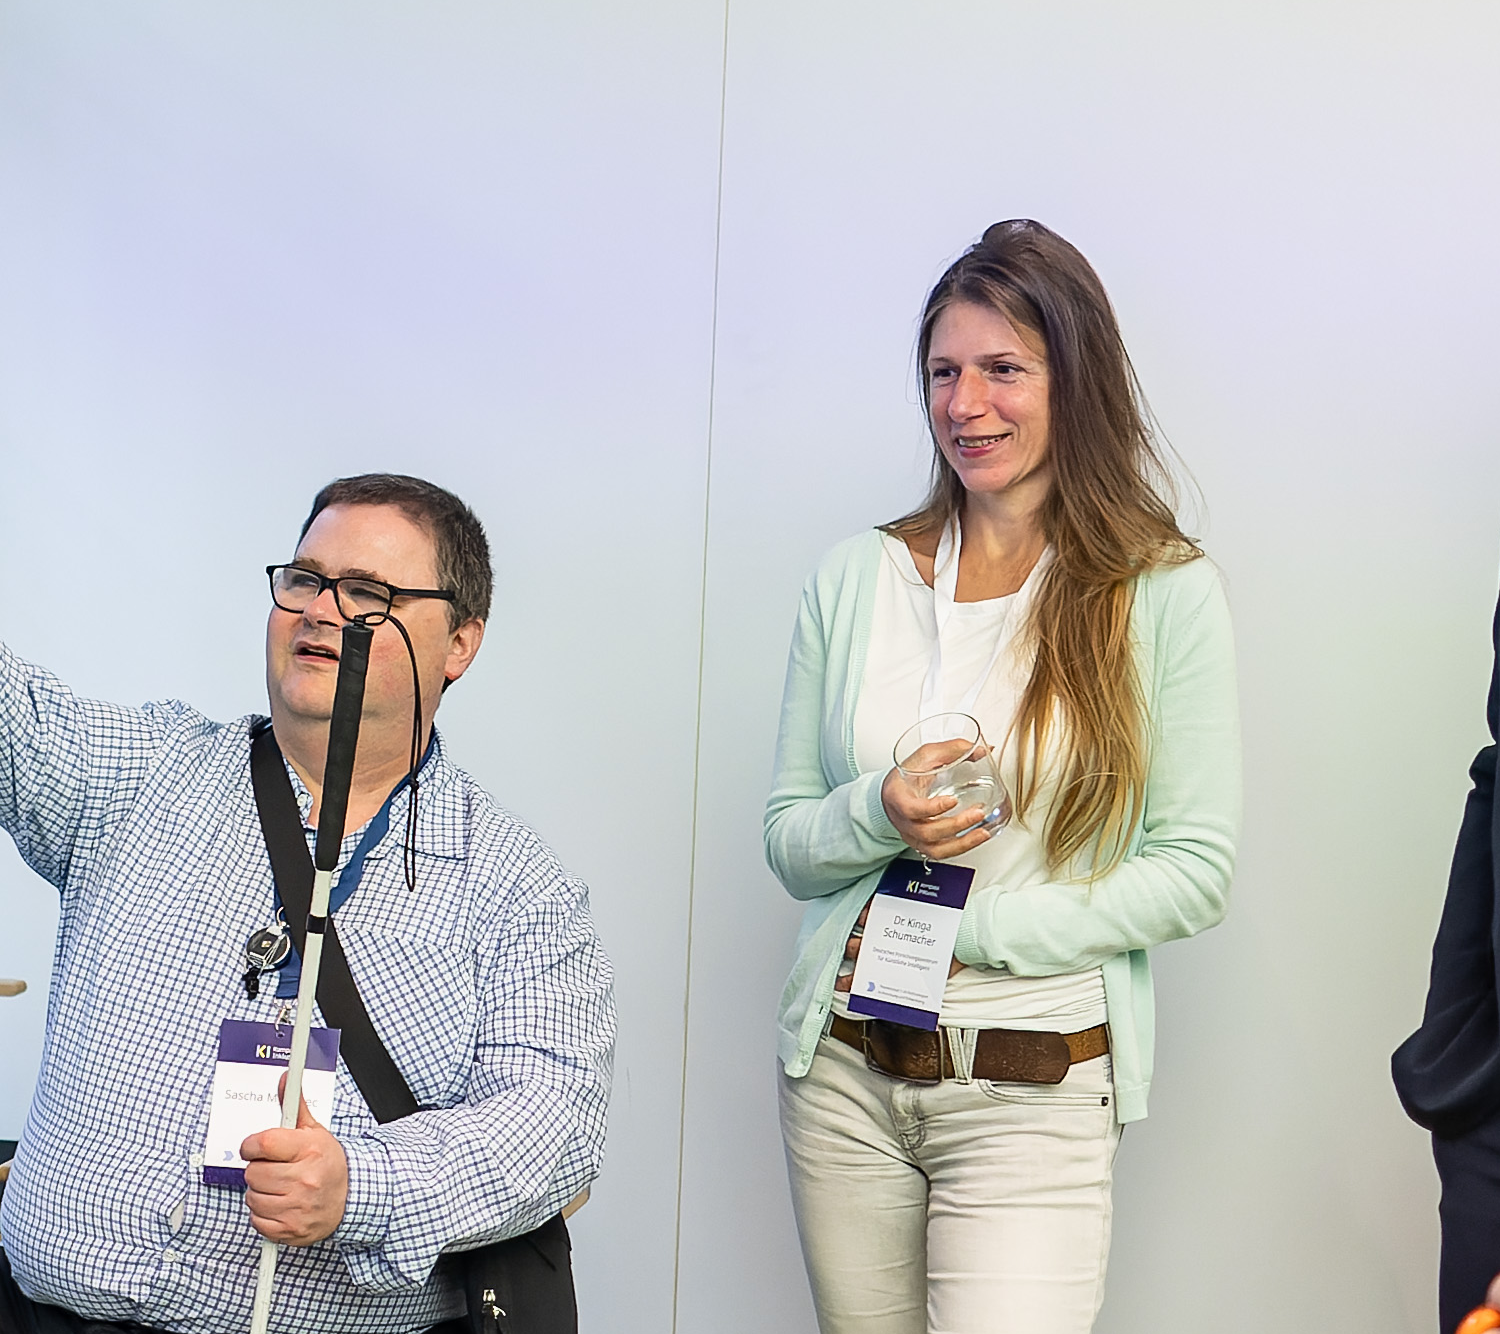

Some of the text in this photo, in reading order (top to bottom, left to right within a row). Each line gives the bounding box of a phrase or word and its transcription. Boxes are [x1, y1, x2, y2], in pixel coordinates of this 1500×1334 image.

[907, 918, 932, 934] Kinga
[883, 927, 937, 947] Schumacher
[256, 1045, 271, 1058] KI
[226, 1090, 263, 1102] Sascha
